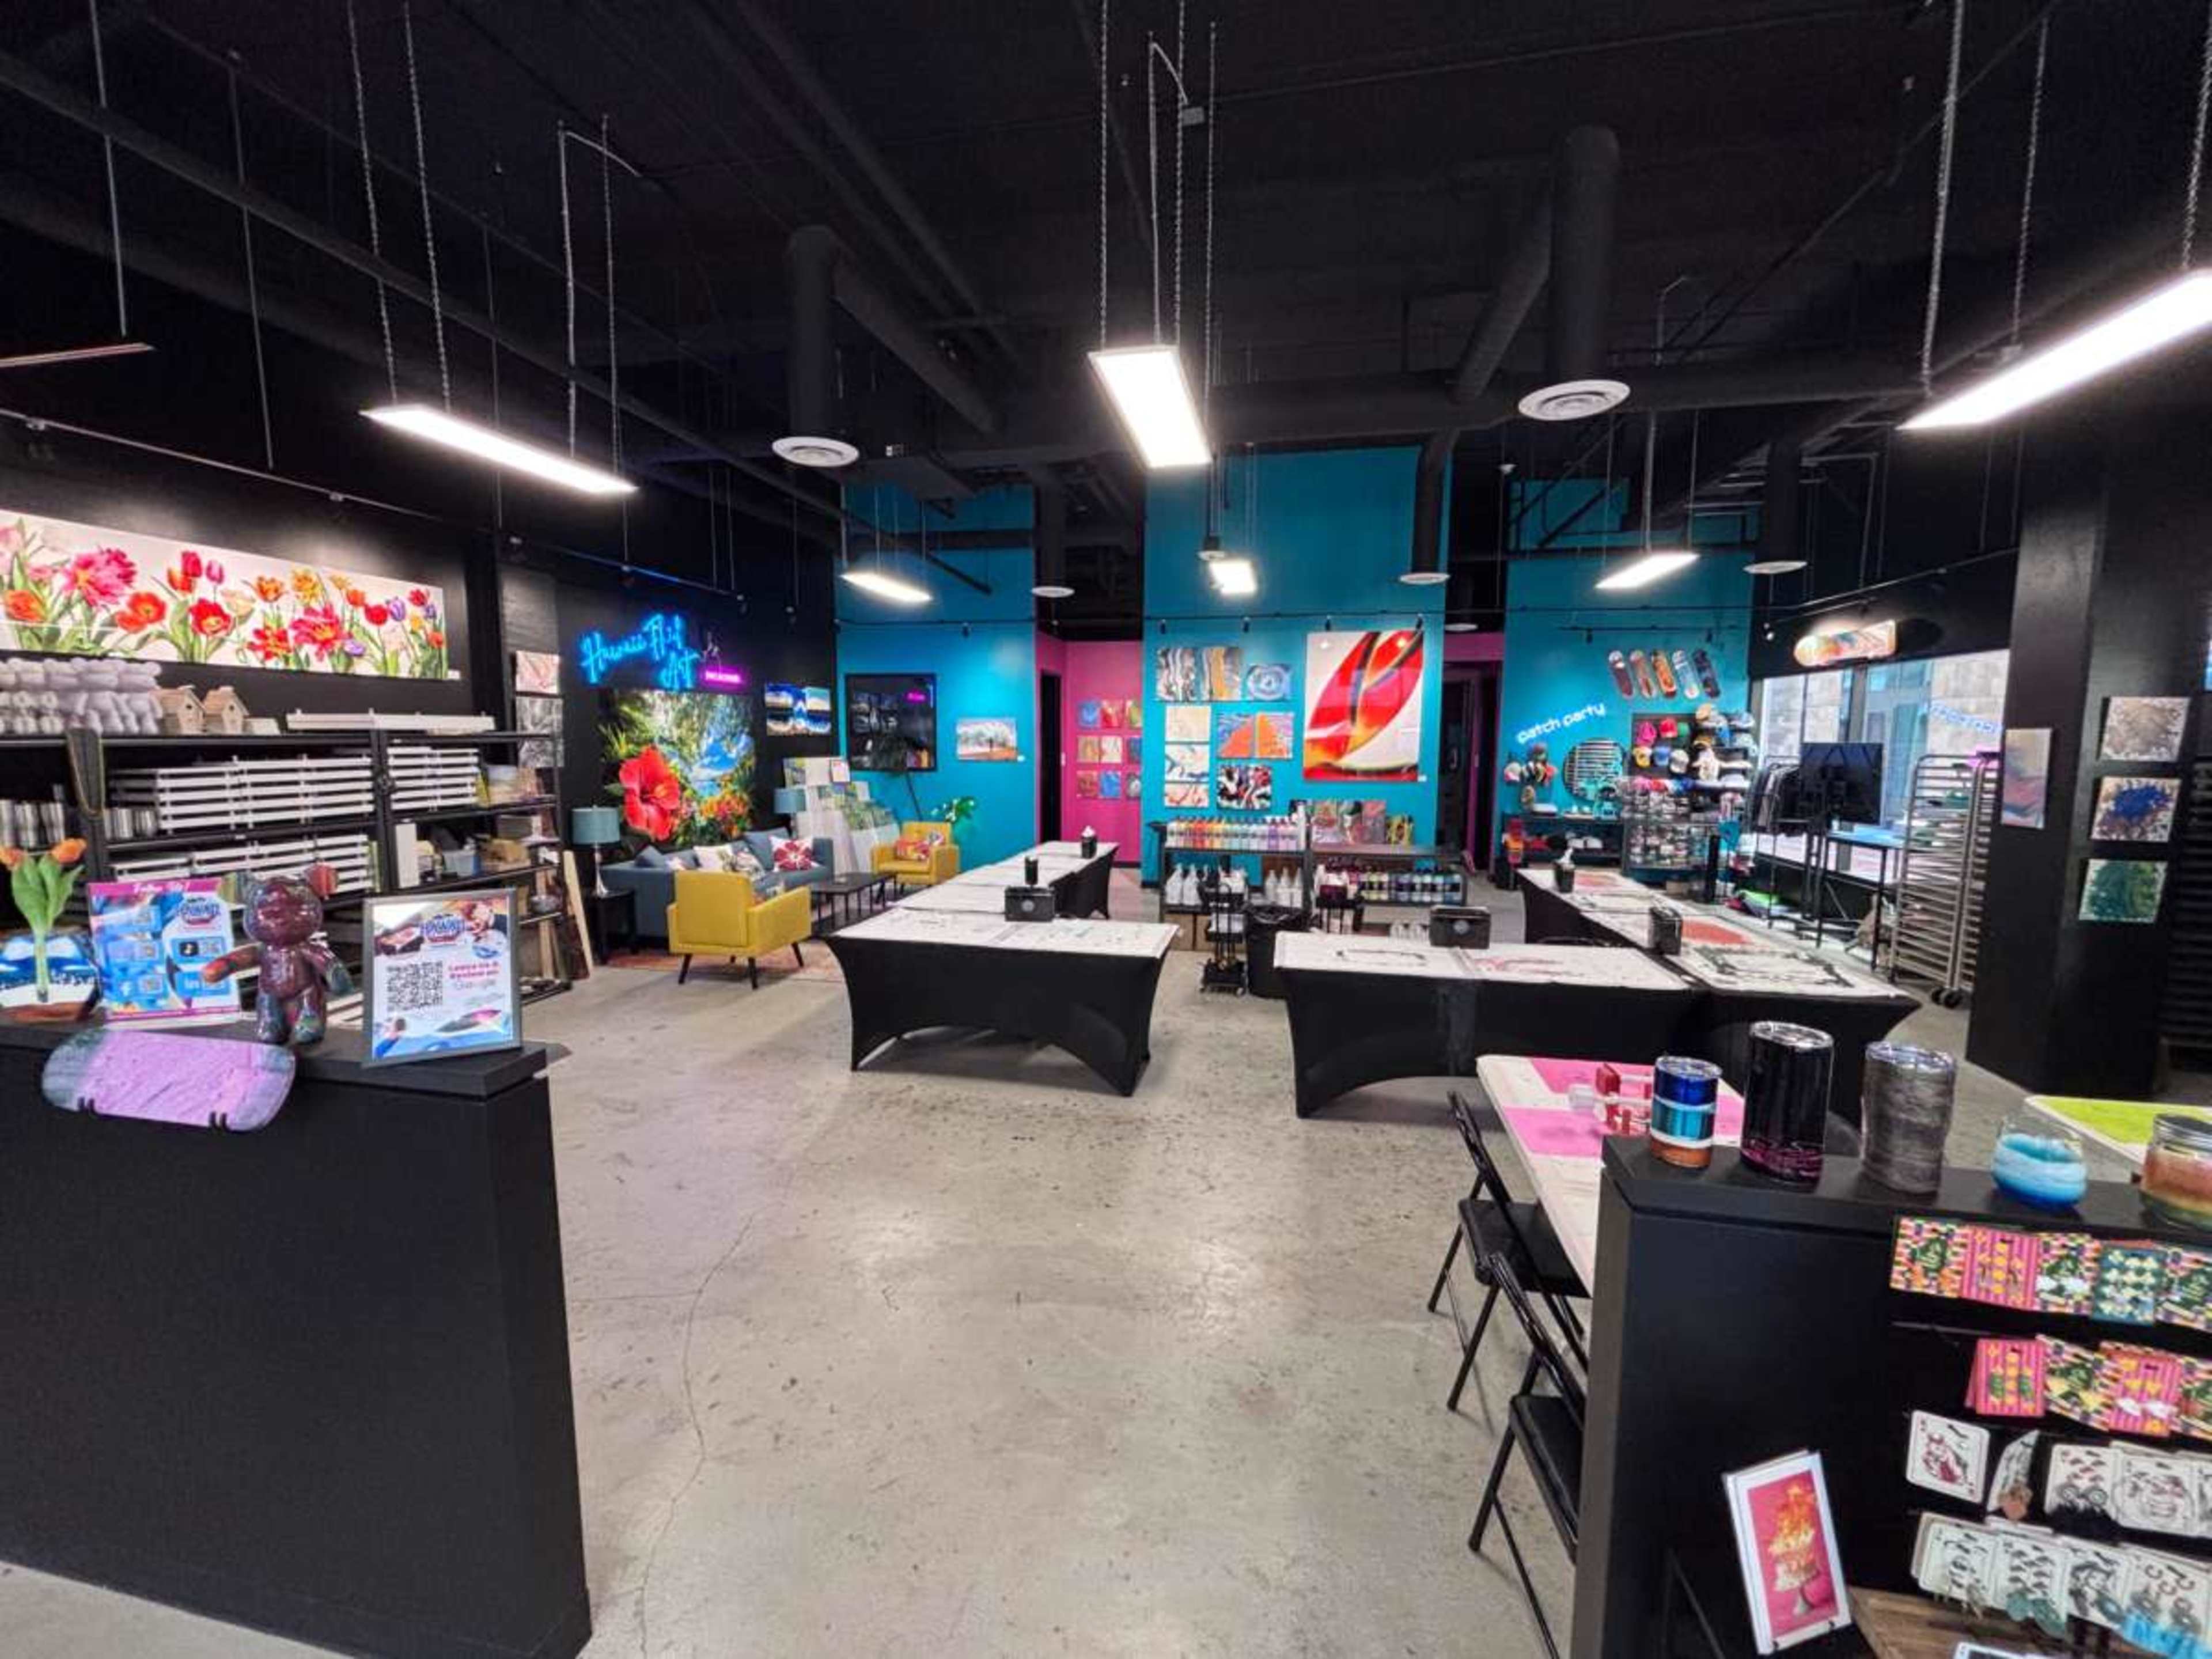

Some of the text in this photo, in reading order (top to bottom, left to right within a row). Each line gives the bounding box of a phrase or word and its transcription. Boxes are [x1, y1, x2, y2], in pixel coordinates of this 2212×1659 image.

[581, 632, 647, 684] Hawaii
[1516, 703, 1606, 744] patch party
